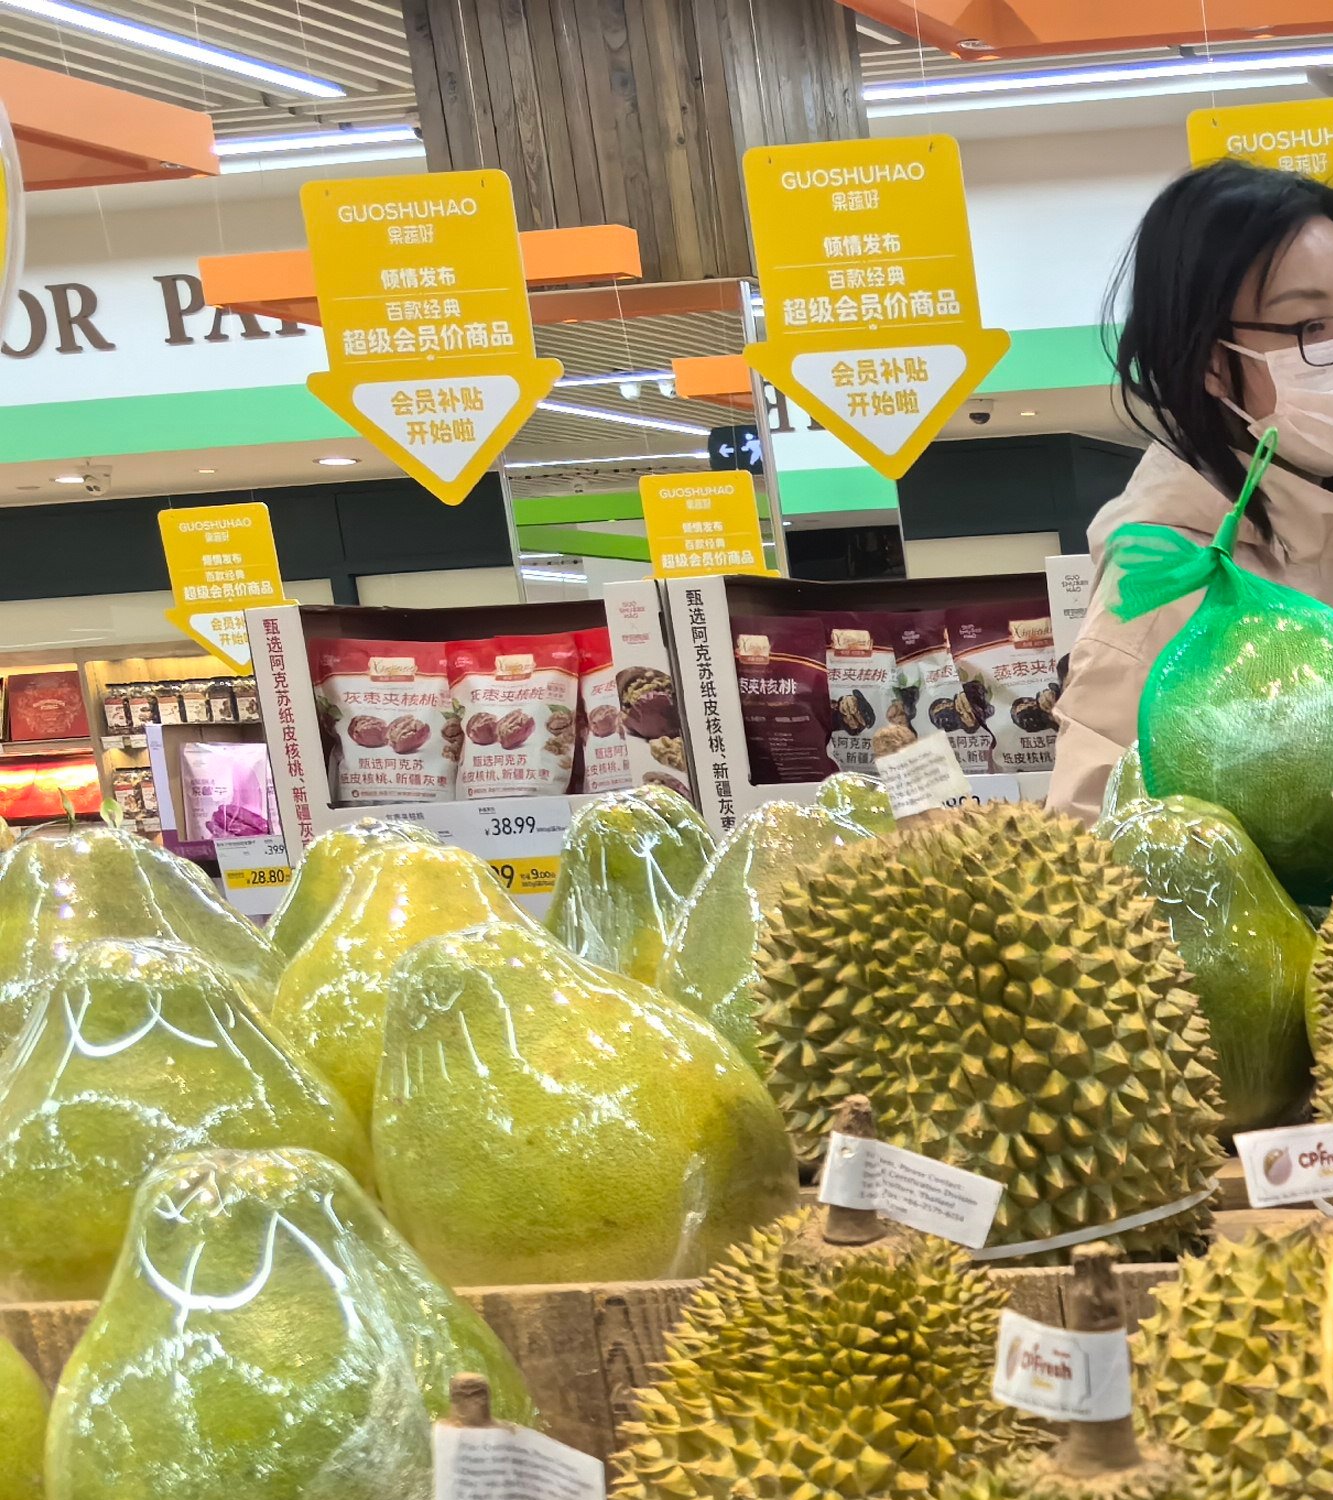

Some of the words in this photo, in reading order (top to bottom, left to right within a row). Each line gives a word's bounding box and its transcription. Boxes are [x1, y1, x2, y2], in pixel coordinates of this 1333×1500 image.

[781, 162, 926, 191] GUOSHUHAO
[338, 198, 477, 224] GUOSHUHAO
[831, 189, 880, 212] 果蔬好
[387, 224, 435, 245] 果蔬好
[823, 233, 901, 258] 倾情发布
[381, 266, 457, 290] 倾情发布
[827, 266, 906, 290] 百款经典
[385, 298, 462, 321] 百款经典
[782, 290, 961, 326] 超级会员价商品
[343, 321, 514, 357] 超级会员价商品
[831, 357, 929, 387] 会员补贴
[390, 387, 484, 416] 会员补贴
[847, 390, 920, 418] 开始啦
[406, 419, 476, 446] 开始啦
[659, 484, 735, 499] GUOSHUHAO
[179, 517, 252, 533] GUOSHUHAO
[661, 551, 755, 570] 超级会员价商品
[184, 580, 274, 601] 超级会员价商品
[685, 589, 737, 832] 甄选阿克苏纸皮核桃、新疆灰枣
[358, 757, 425, 771] 甄选阿克苏
[472, 753, 528, 768] 甄选阿克苏
[484, 815, 536, 837] ¥38.99
